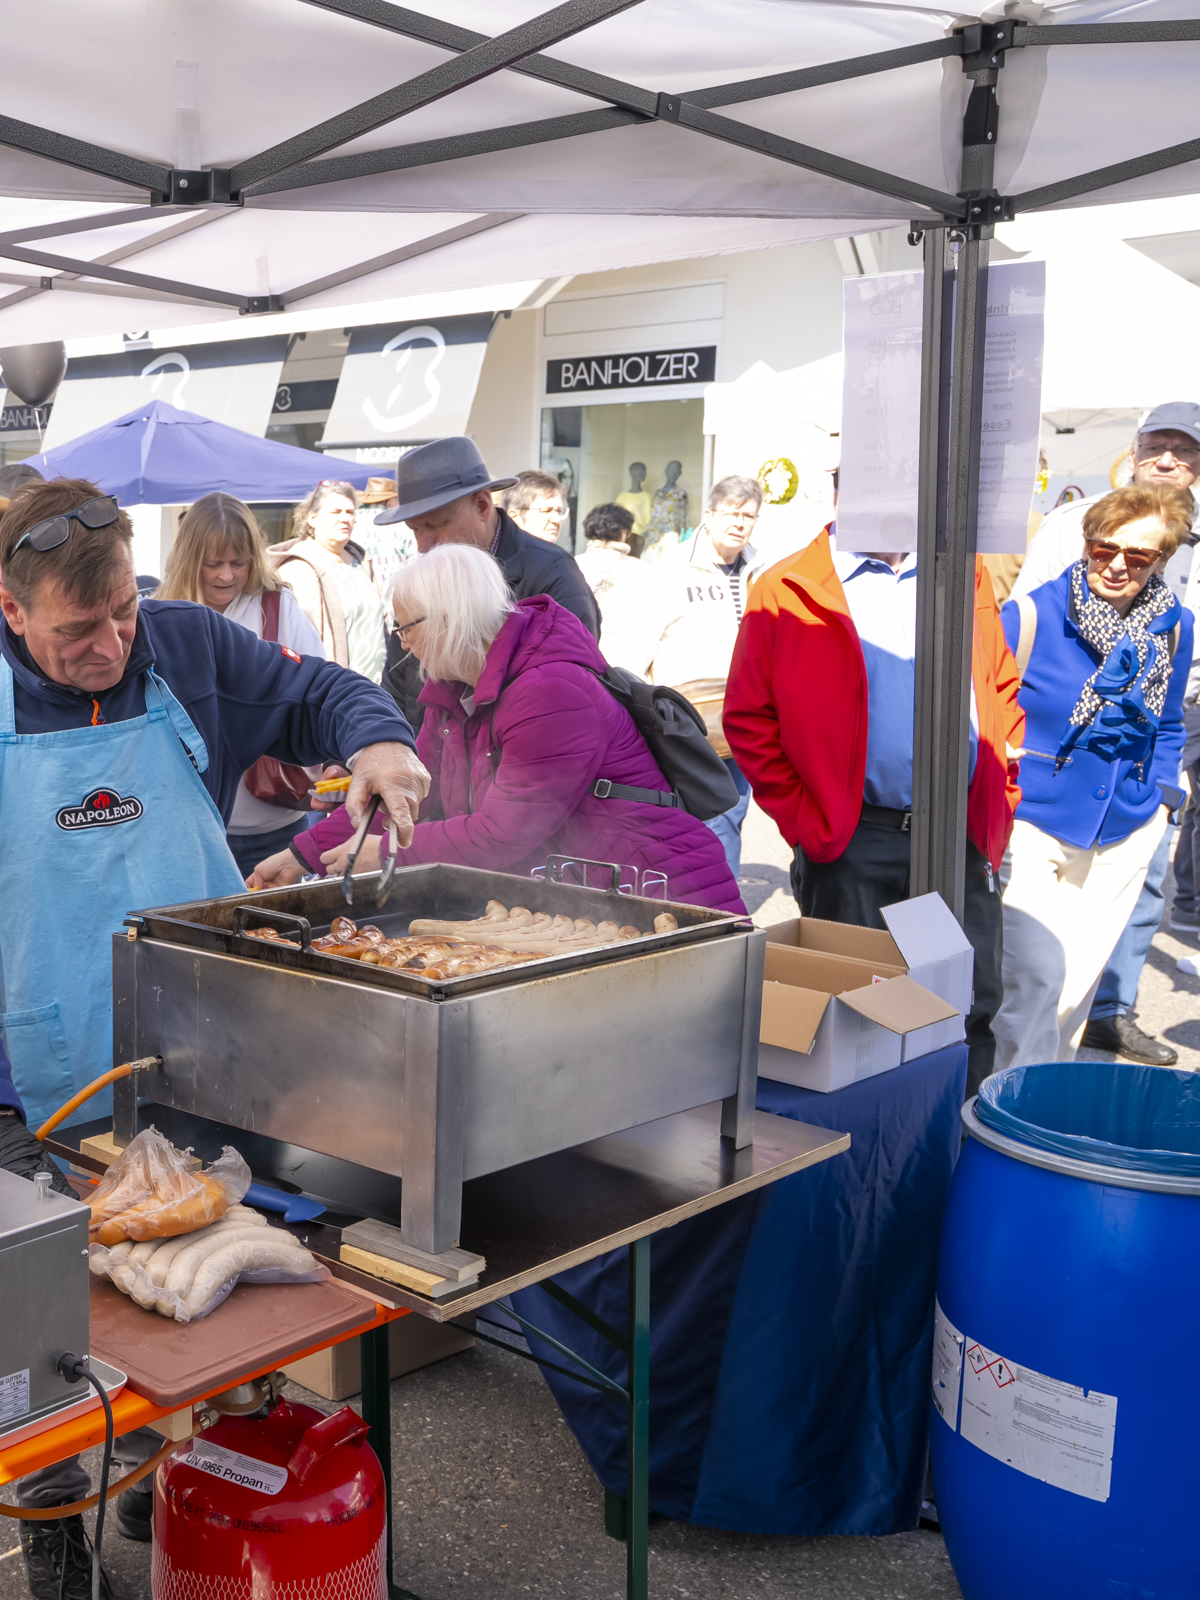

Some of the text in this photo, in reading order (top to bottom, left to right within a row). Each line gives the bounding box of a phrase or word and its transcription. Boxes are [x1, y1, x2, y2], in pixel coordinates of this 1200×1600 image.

[561, 352, 699, 388] BANHOLZER
[64, 803, 136, 825] NAPOLEON
[5, 1373, 22, 1384] CUTTER
[186, 1453, 201, 1467] UN
[200, 1460, 223, 1475] 1965
[223, 1468, 263, 1489] Propan
[232, 1517, 270, 1533] UN1965
